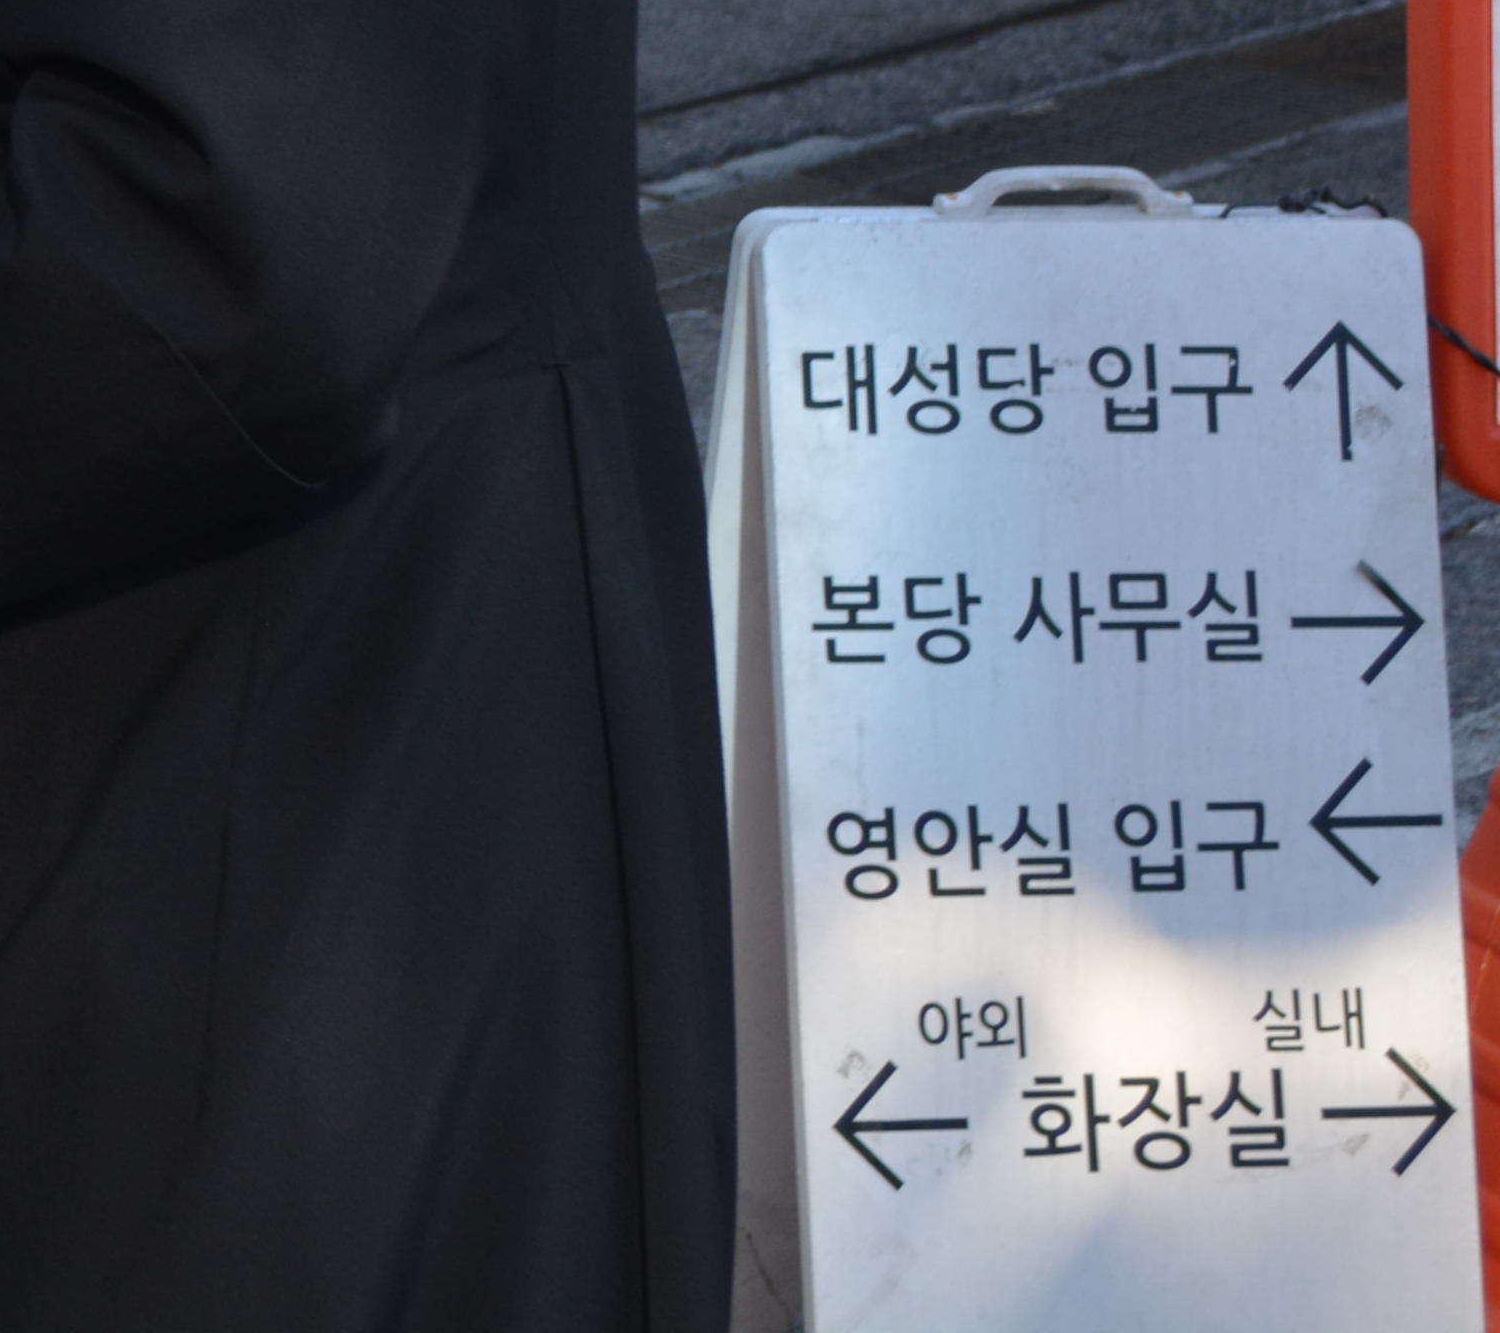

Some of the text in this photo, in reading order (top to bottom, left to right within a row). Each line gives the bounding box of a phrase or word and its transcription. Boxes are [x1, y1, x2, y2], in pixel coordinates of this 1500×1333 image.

[801, 343, 1253, 435] 대성당 입구
[812, 569, 1263, 665] 본당 사무실
[827, 799, 1280, 900] 영안실 입구
[918, 986, 1365, 1060] 야외 실내
[1021, 1068, 1290, 1173] 화장실
